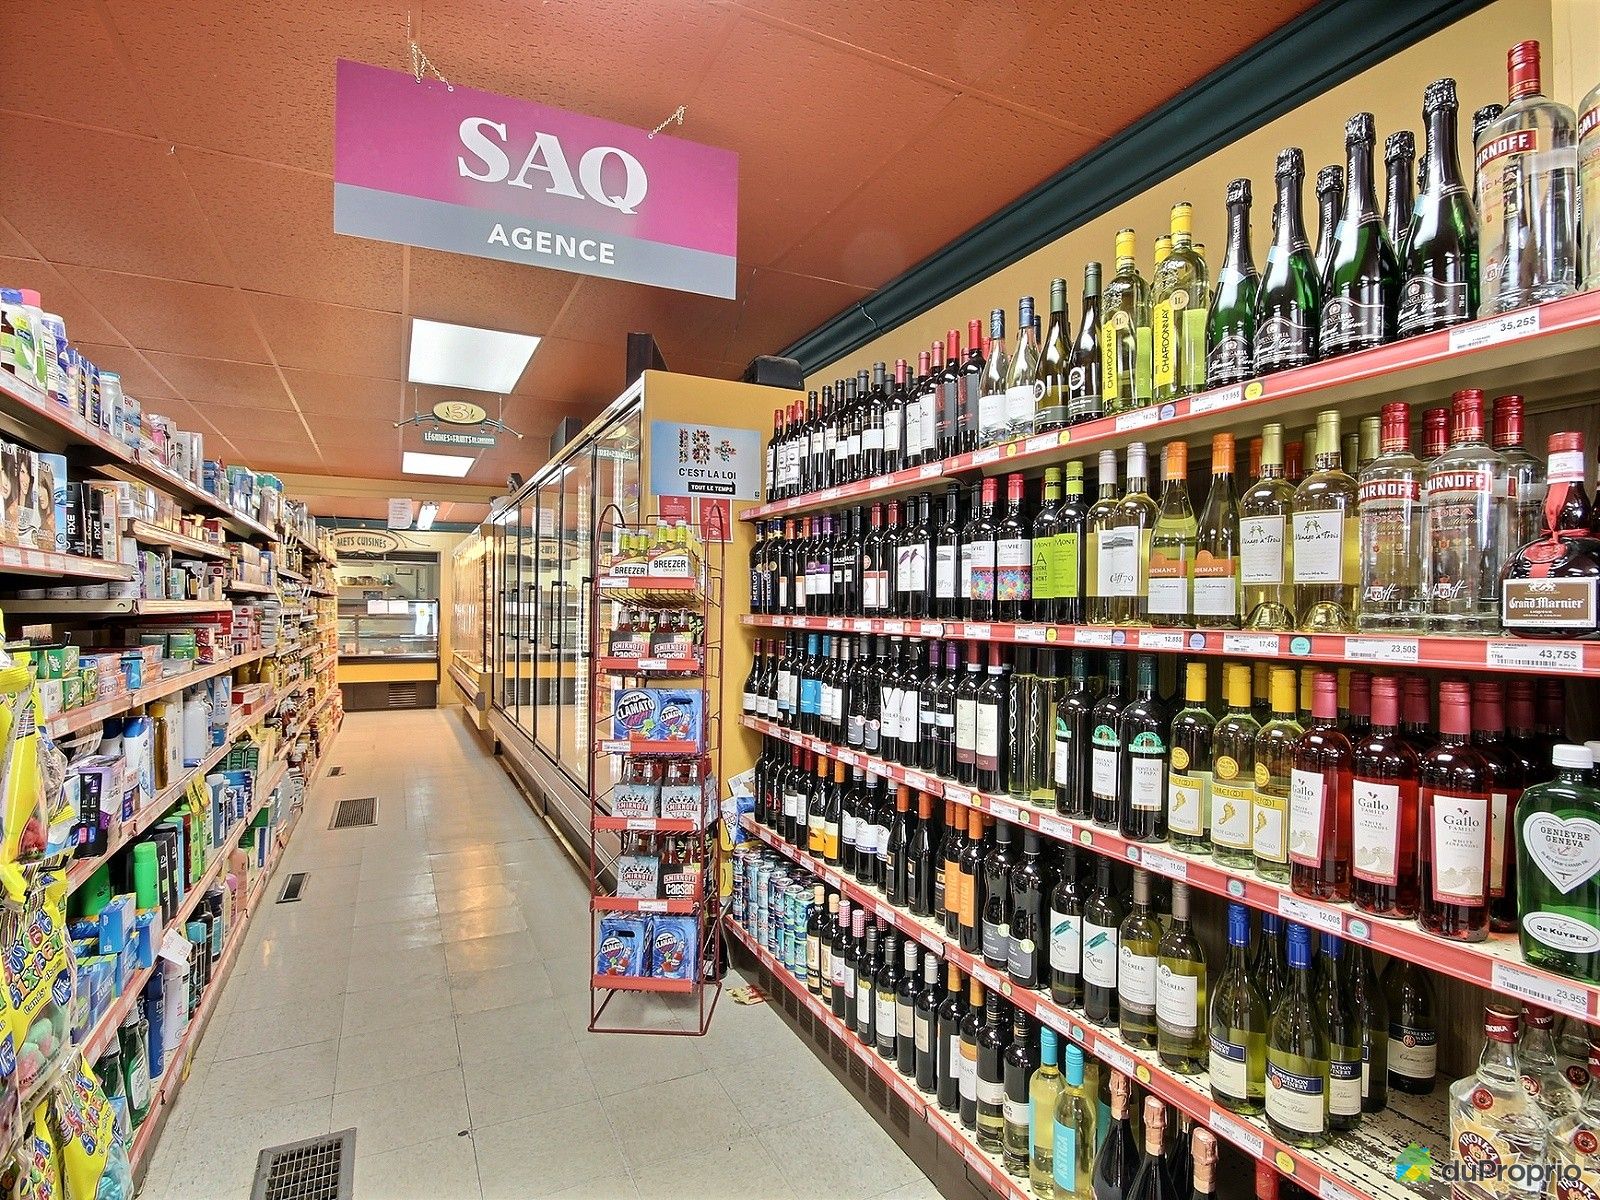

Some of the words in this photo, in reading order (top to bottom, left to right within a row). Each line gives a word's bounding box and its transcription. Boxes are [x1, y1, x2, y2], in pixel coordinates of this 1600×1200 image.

[457, 117, 648, 215] SAQ
[487, 223, 615, 265] AGENCE
[1161, 308, 1169, 373] CHARDONNAY
[678, 467, 704, 478] C'EST
[707, 470, 719, 478] LA
[722, 471, 736, 480] LOI
[67, 514, 76, 535] AXE
[93, 520, 101, 540] AXE
[337, 536, 355, 547] METS
[614, 566, 646, 575] BREEZER
[653, 559, 686, 569] BREEZER
[1509, 597, 1535, 609] Grand
[1536, 597, 1584, 609] Marnier
[1391, 644, 1417, 653] 23,50$
[1539, 649, 1577, 660] 43,75$
[617, 802, 649, 811] SMIRNOFF
[666, 802, 697, 812] SMIRNOFF
[1358, 797, 1389, 811] Gallo
[1443, 814, 1480, 827] Gallo
[1545, 835, 1584, 848] GENEVA
[623, 872, 653, 881] SMIRNOFF
[1537, 924, 1547, 932] DE
[1549, 927, 1589, 943] KUYPER
[1271, 1067, 1309, 1086] ROBERTSON
[1281, 1079, 1308, 1090] WINERY
[1460, 1133, 1499, 1161] TROIKA
